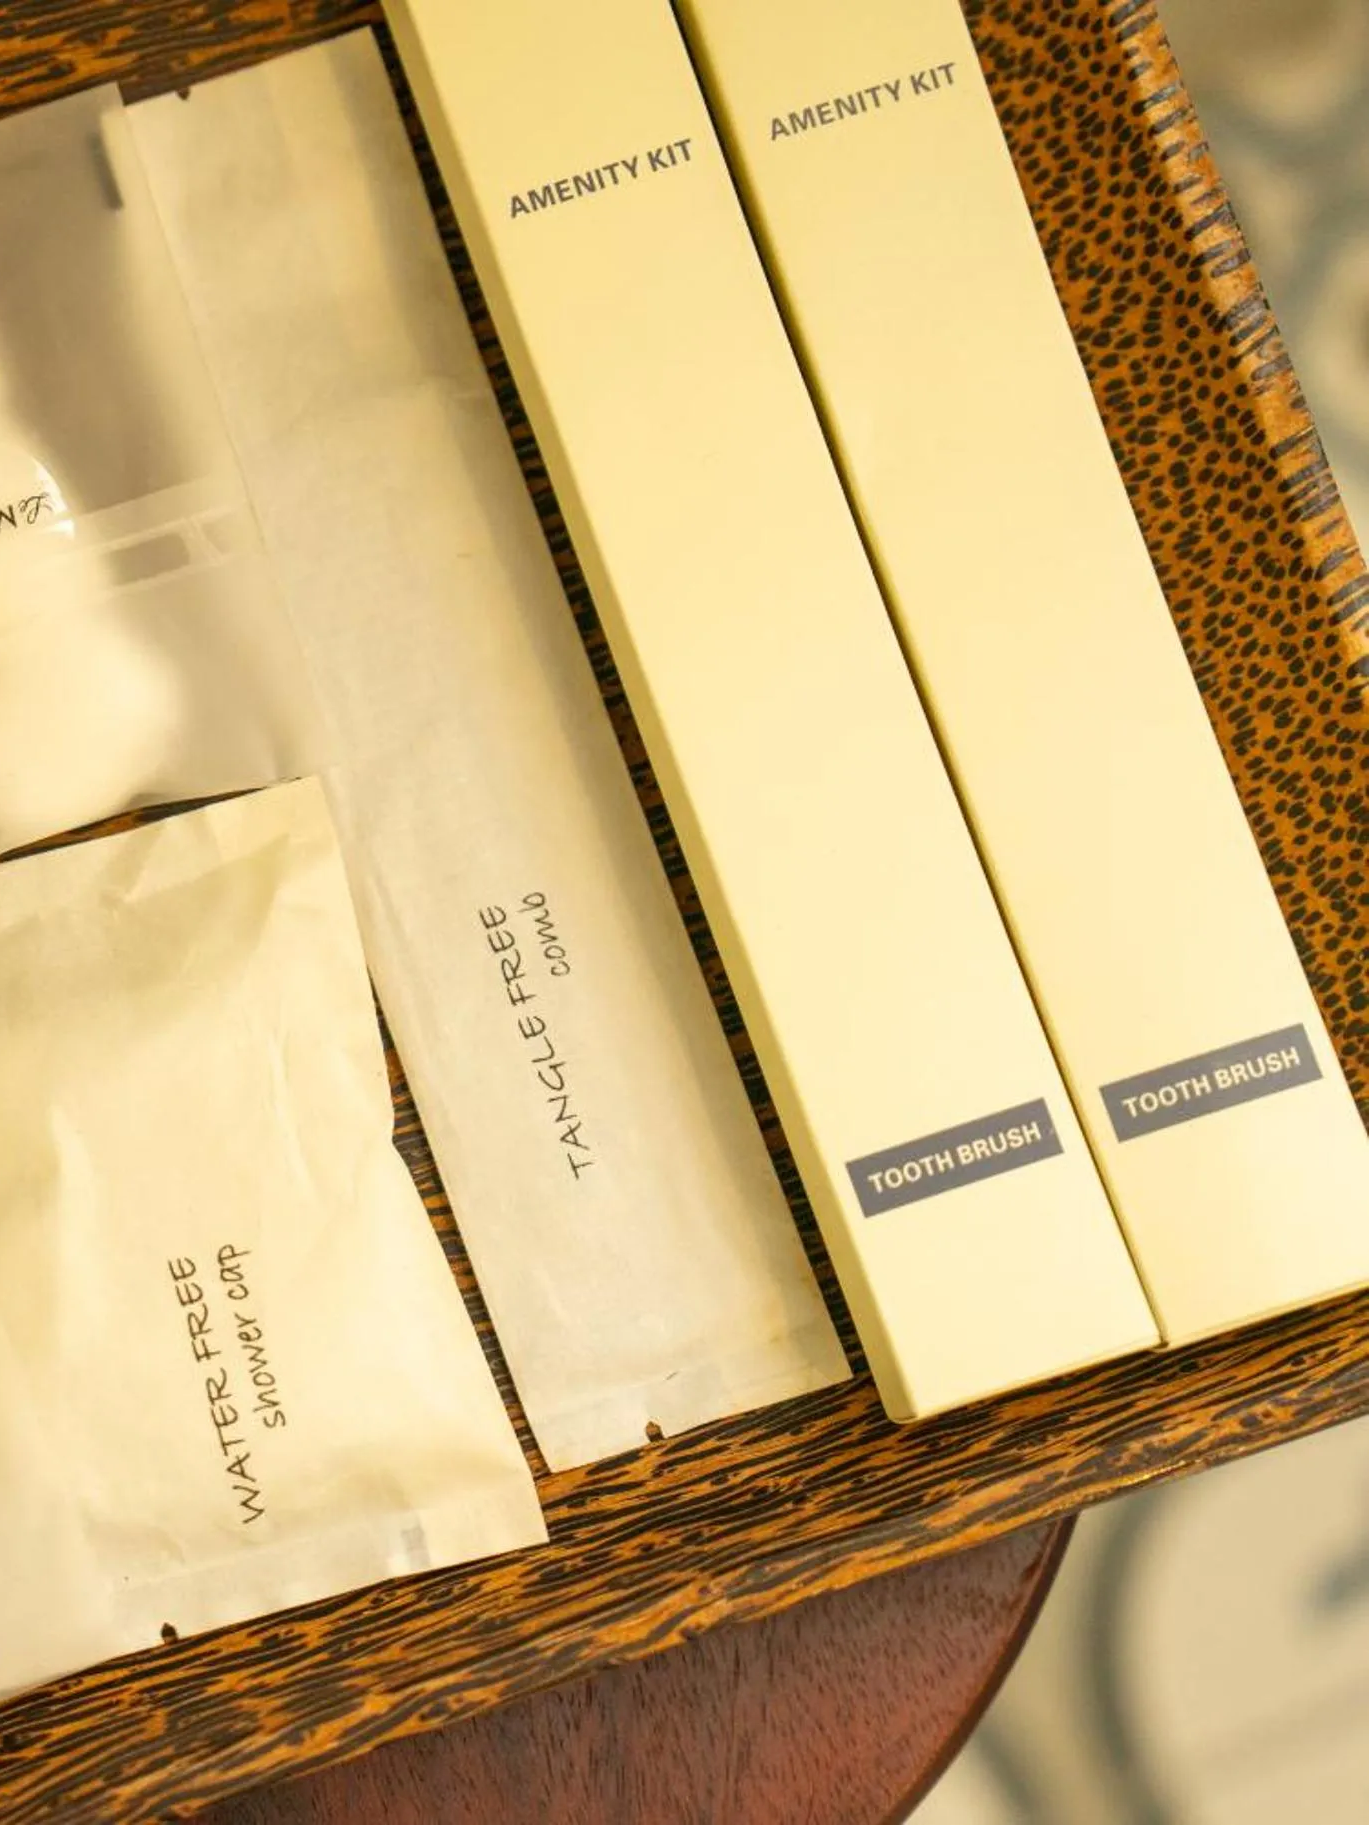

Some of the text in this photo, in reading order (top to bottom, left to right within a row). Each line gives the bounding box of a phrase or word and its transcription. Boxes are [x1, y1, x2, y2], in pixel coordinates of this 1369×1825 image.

[769, 62, 958, 141] AMENITY KIT
[509, 138, 694, 219] AMENITY KIT
[517, 891, 571, 977] comb
[479, 904, 594, 1180] TANGLE FREE
[1122, 1046, 1302, 1119] TOOTH BRUSH
[867, 1121, 1042, 1195] TOOTH BRUSH
[217, 1243, 286, 1429] shower cap
[168, 1256, 265, 1524] WATER FREE
